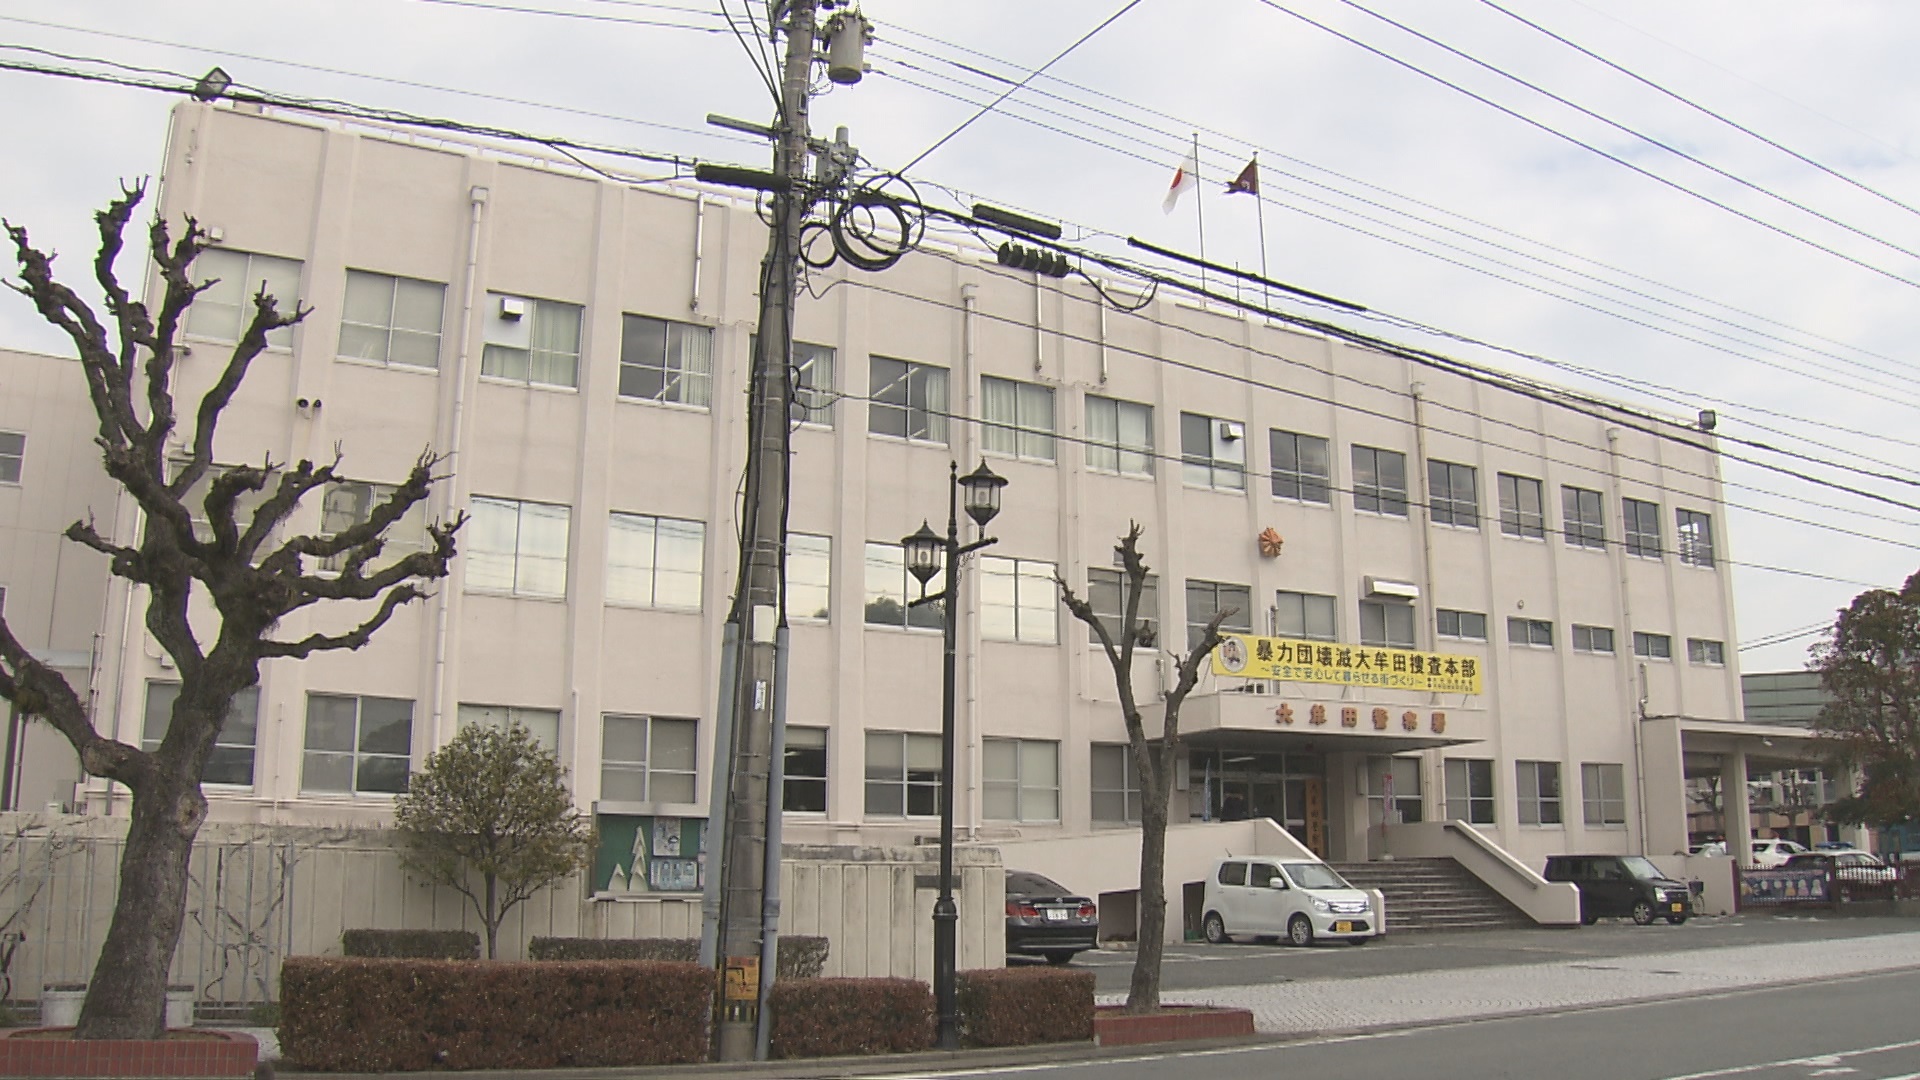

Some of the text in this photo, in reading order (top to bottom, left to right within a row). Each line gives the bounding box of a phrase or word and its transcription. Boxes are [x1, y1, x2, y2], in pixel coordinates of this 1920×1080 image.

[1256, 639, 1476, 678] 暴力団壊滅大牟田捜査本部
